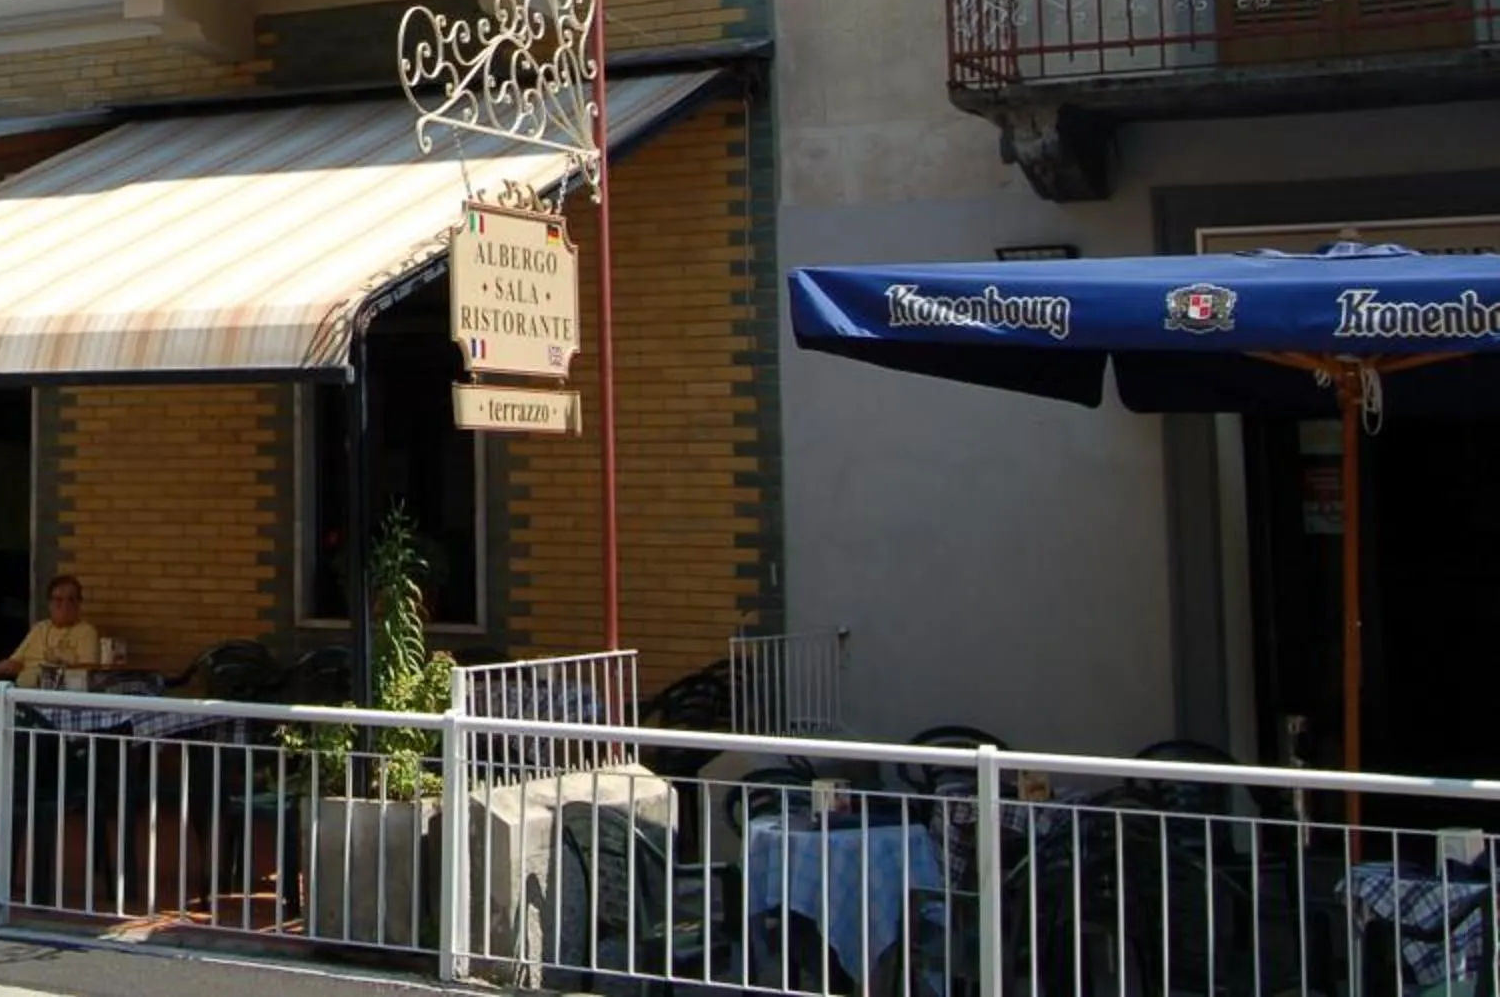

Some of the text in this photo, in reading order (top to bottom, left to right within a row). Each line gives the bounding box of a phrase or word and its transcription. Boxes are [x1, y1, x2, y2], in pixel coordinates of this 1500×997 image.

[475, 241, 558, 275] ALBERGO
[494, 276, 539, 305] SALA
[461, 305, 574, 341] RISTORANTE
[884, 284, 1071, 340] Kronenbourg
[488, 399, 550, 422] terrazzo
